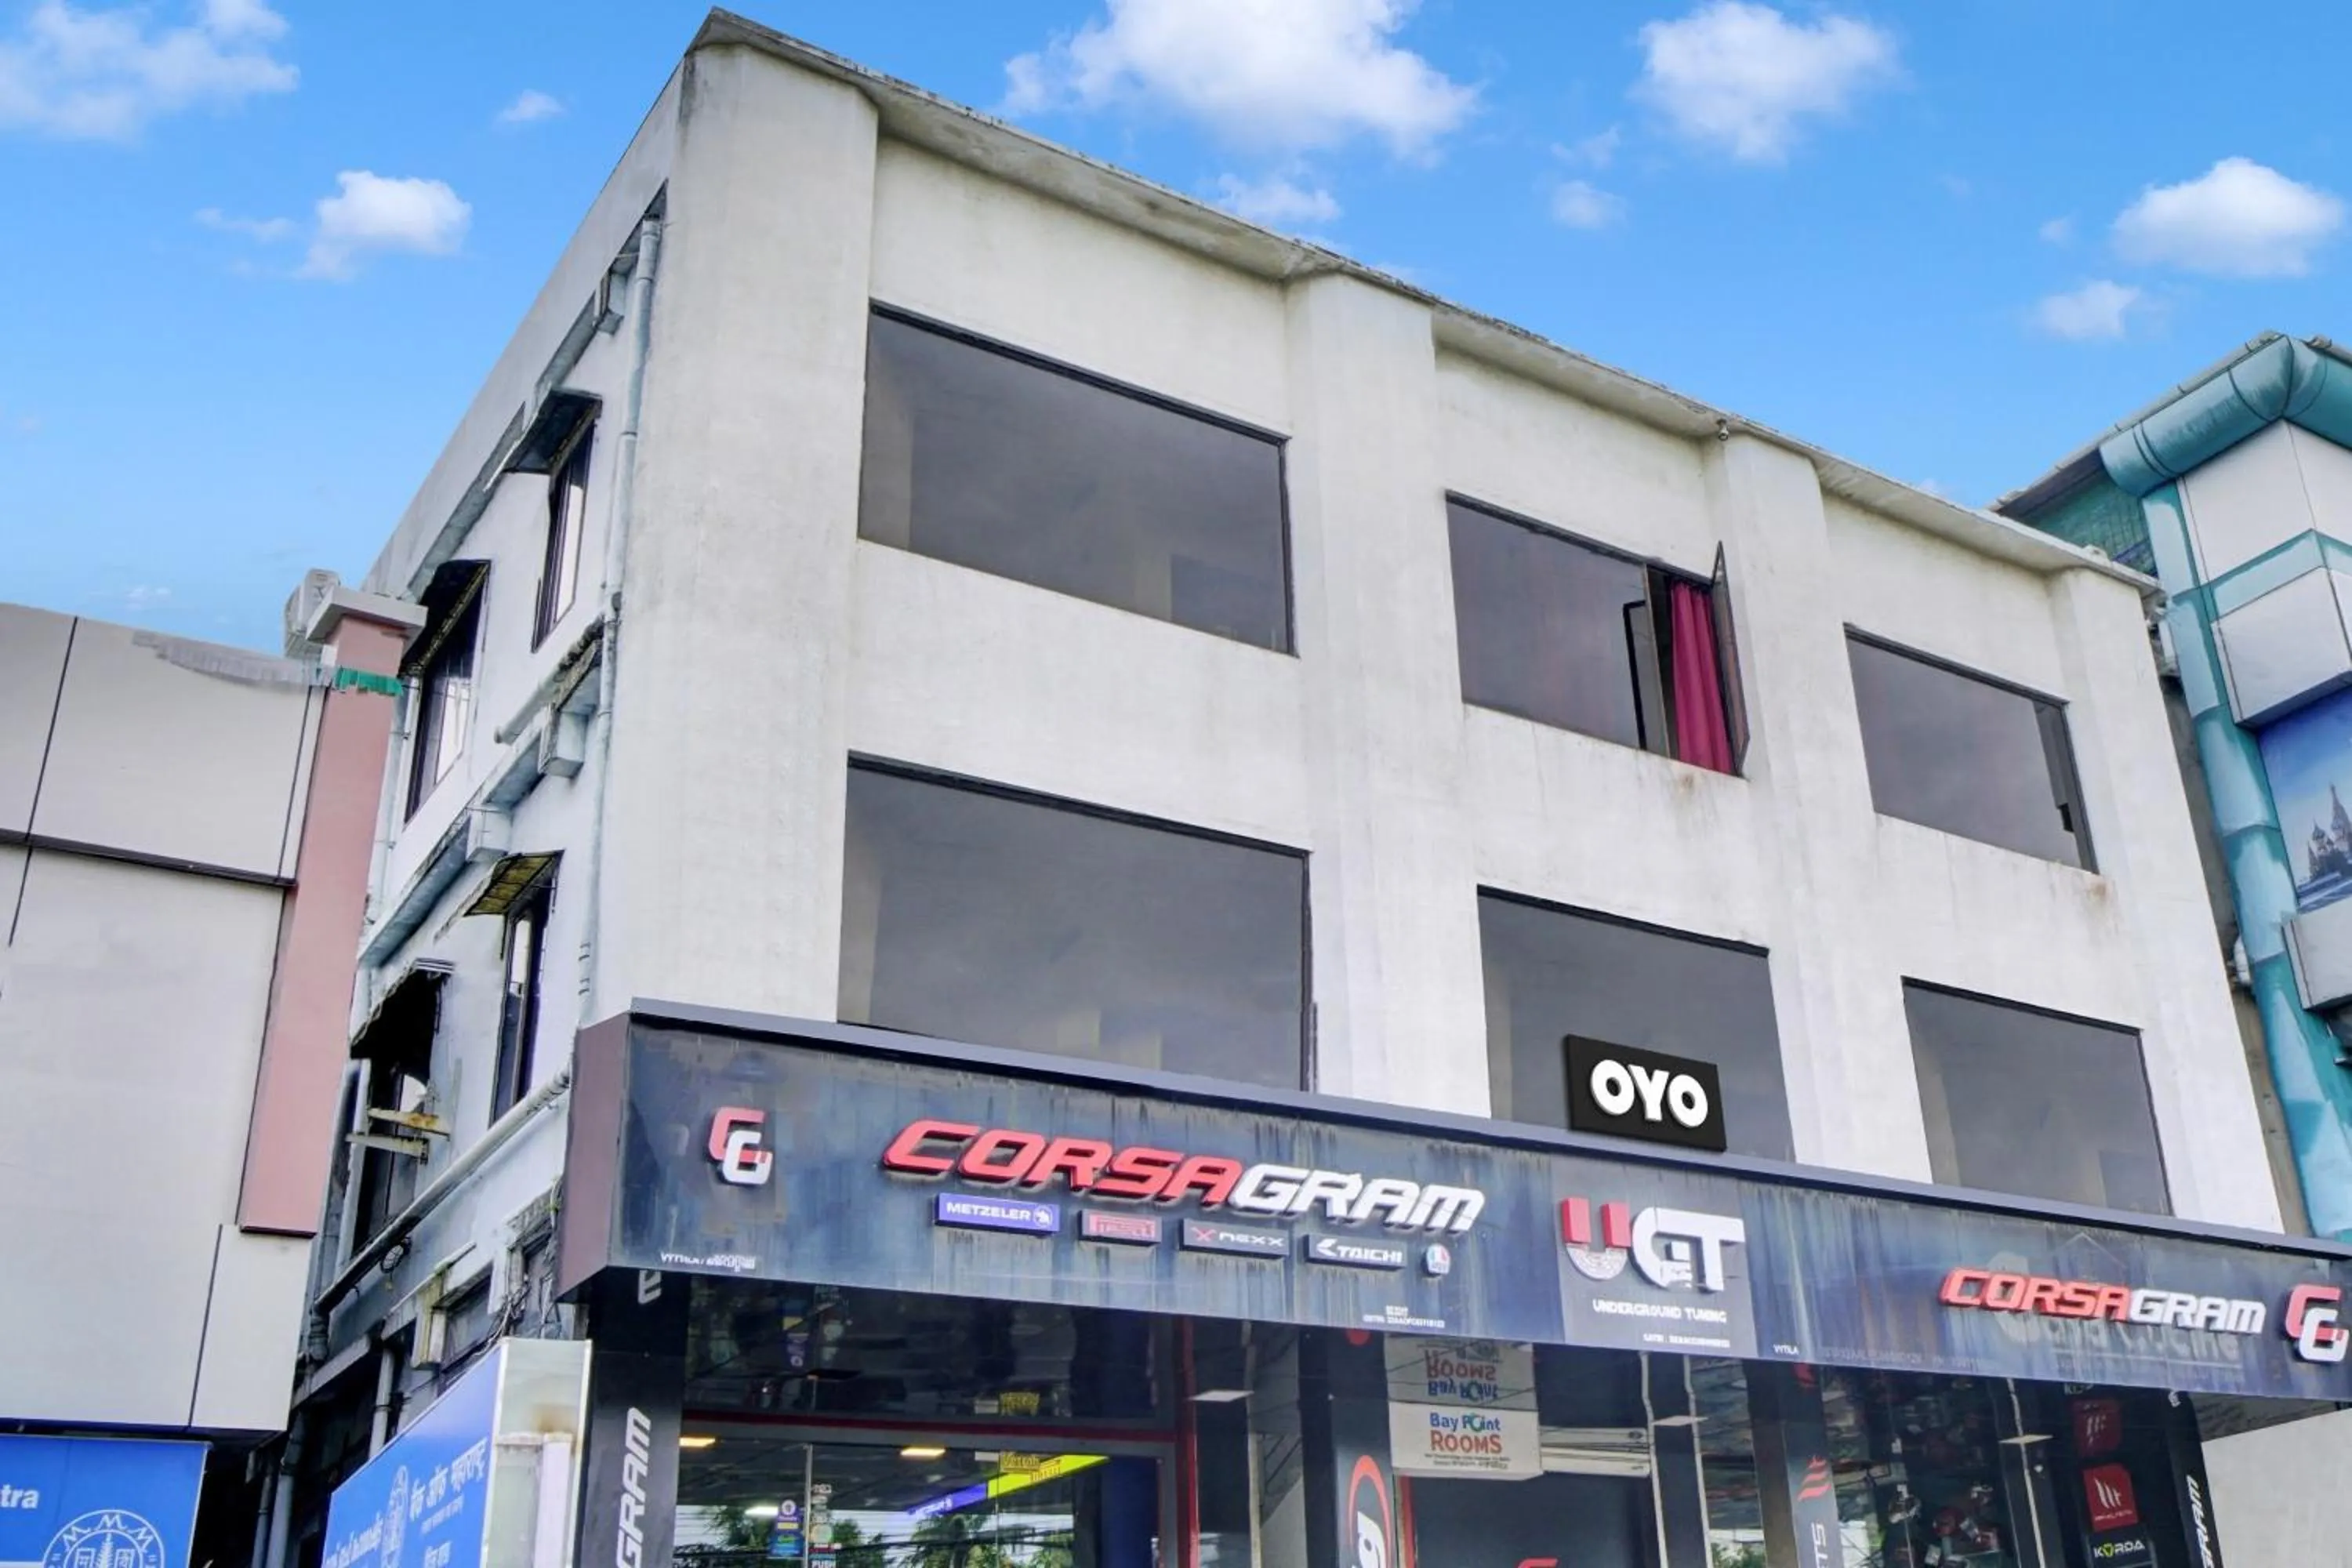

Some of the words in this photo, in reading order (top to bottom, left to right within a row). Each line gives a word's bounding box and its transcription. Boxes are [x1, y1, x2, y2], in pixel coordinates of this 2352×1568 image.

[1590, 1059, 1709, 1128] OYO
[946, 1202, 1032, 1220] METZELER
[1336, 1245, 1403, 1263] TAICHI
[1560, 1197, 1746, 1292] UGT
[1592, 1298, 1682, 1319] UNDERGROUND
[1683, 1306, 1727, 1323] TUNING
[1429, 1413, 1459, 1432] Bay
[1461, 1412, 1501, 1432] Point
[1429, 1429, 1503, 1454] ROOMS
